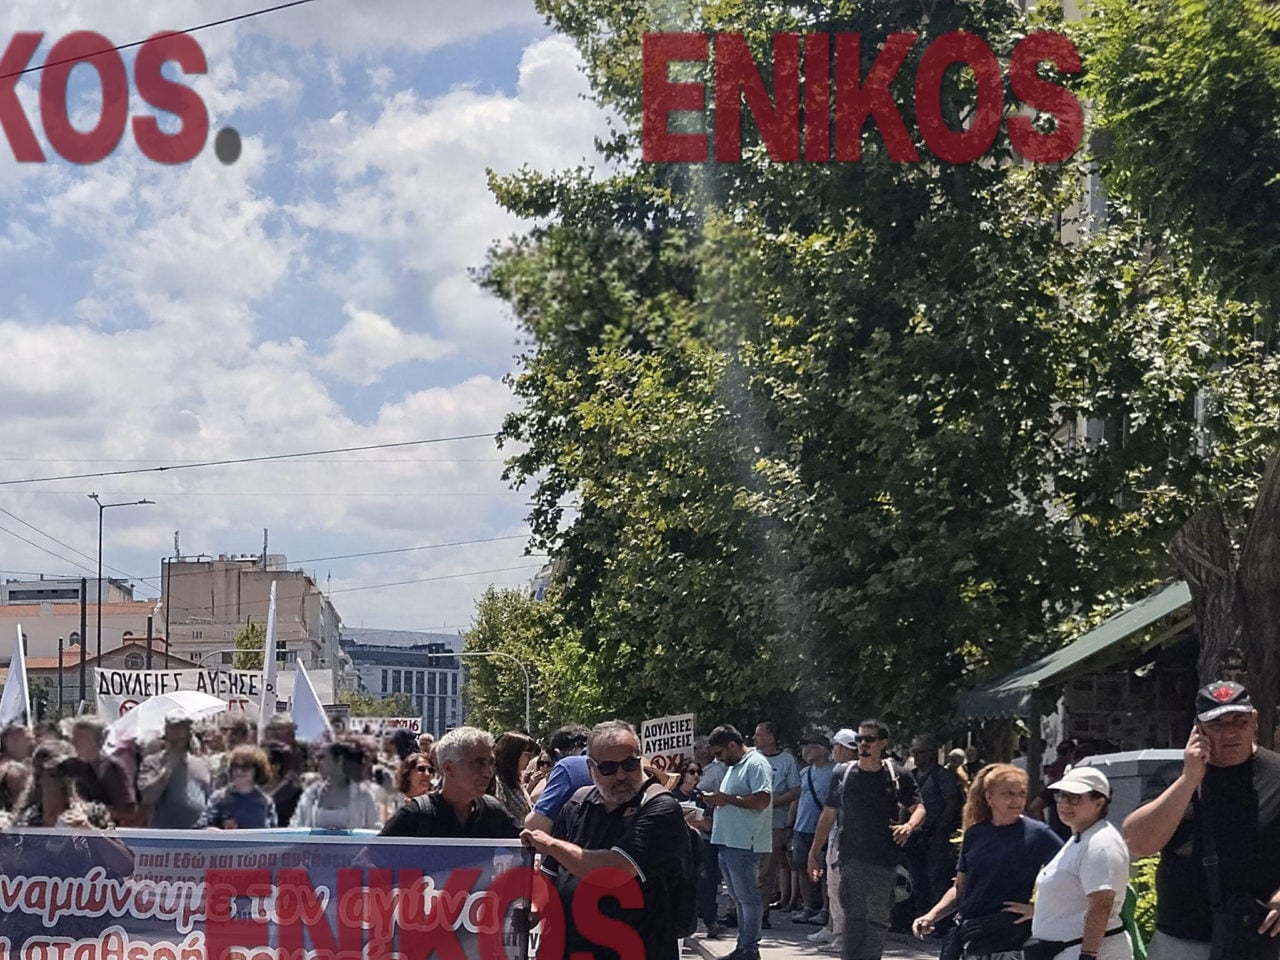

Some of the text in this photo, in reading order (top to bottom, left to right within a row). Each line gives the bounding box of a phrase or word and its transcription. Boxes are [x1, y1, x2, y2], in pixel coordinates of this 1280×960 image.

[99, 670, 183, 697] ΔΟΥΛΕΙΕΣ
[644, 719, 692, 739] ΔΟΥΛΕΙΕΣ
[644, 734, 692, 754] ΑΥΞΗΣΕΙΣ
[173, 851, 206, 869] Εδώ
[246, 884, 330, 926] τον
[337, 875, 500, 942] αγώνα
